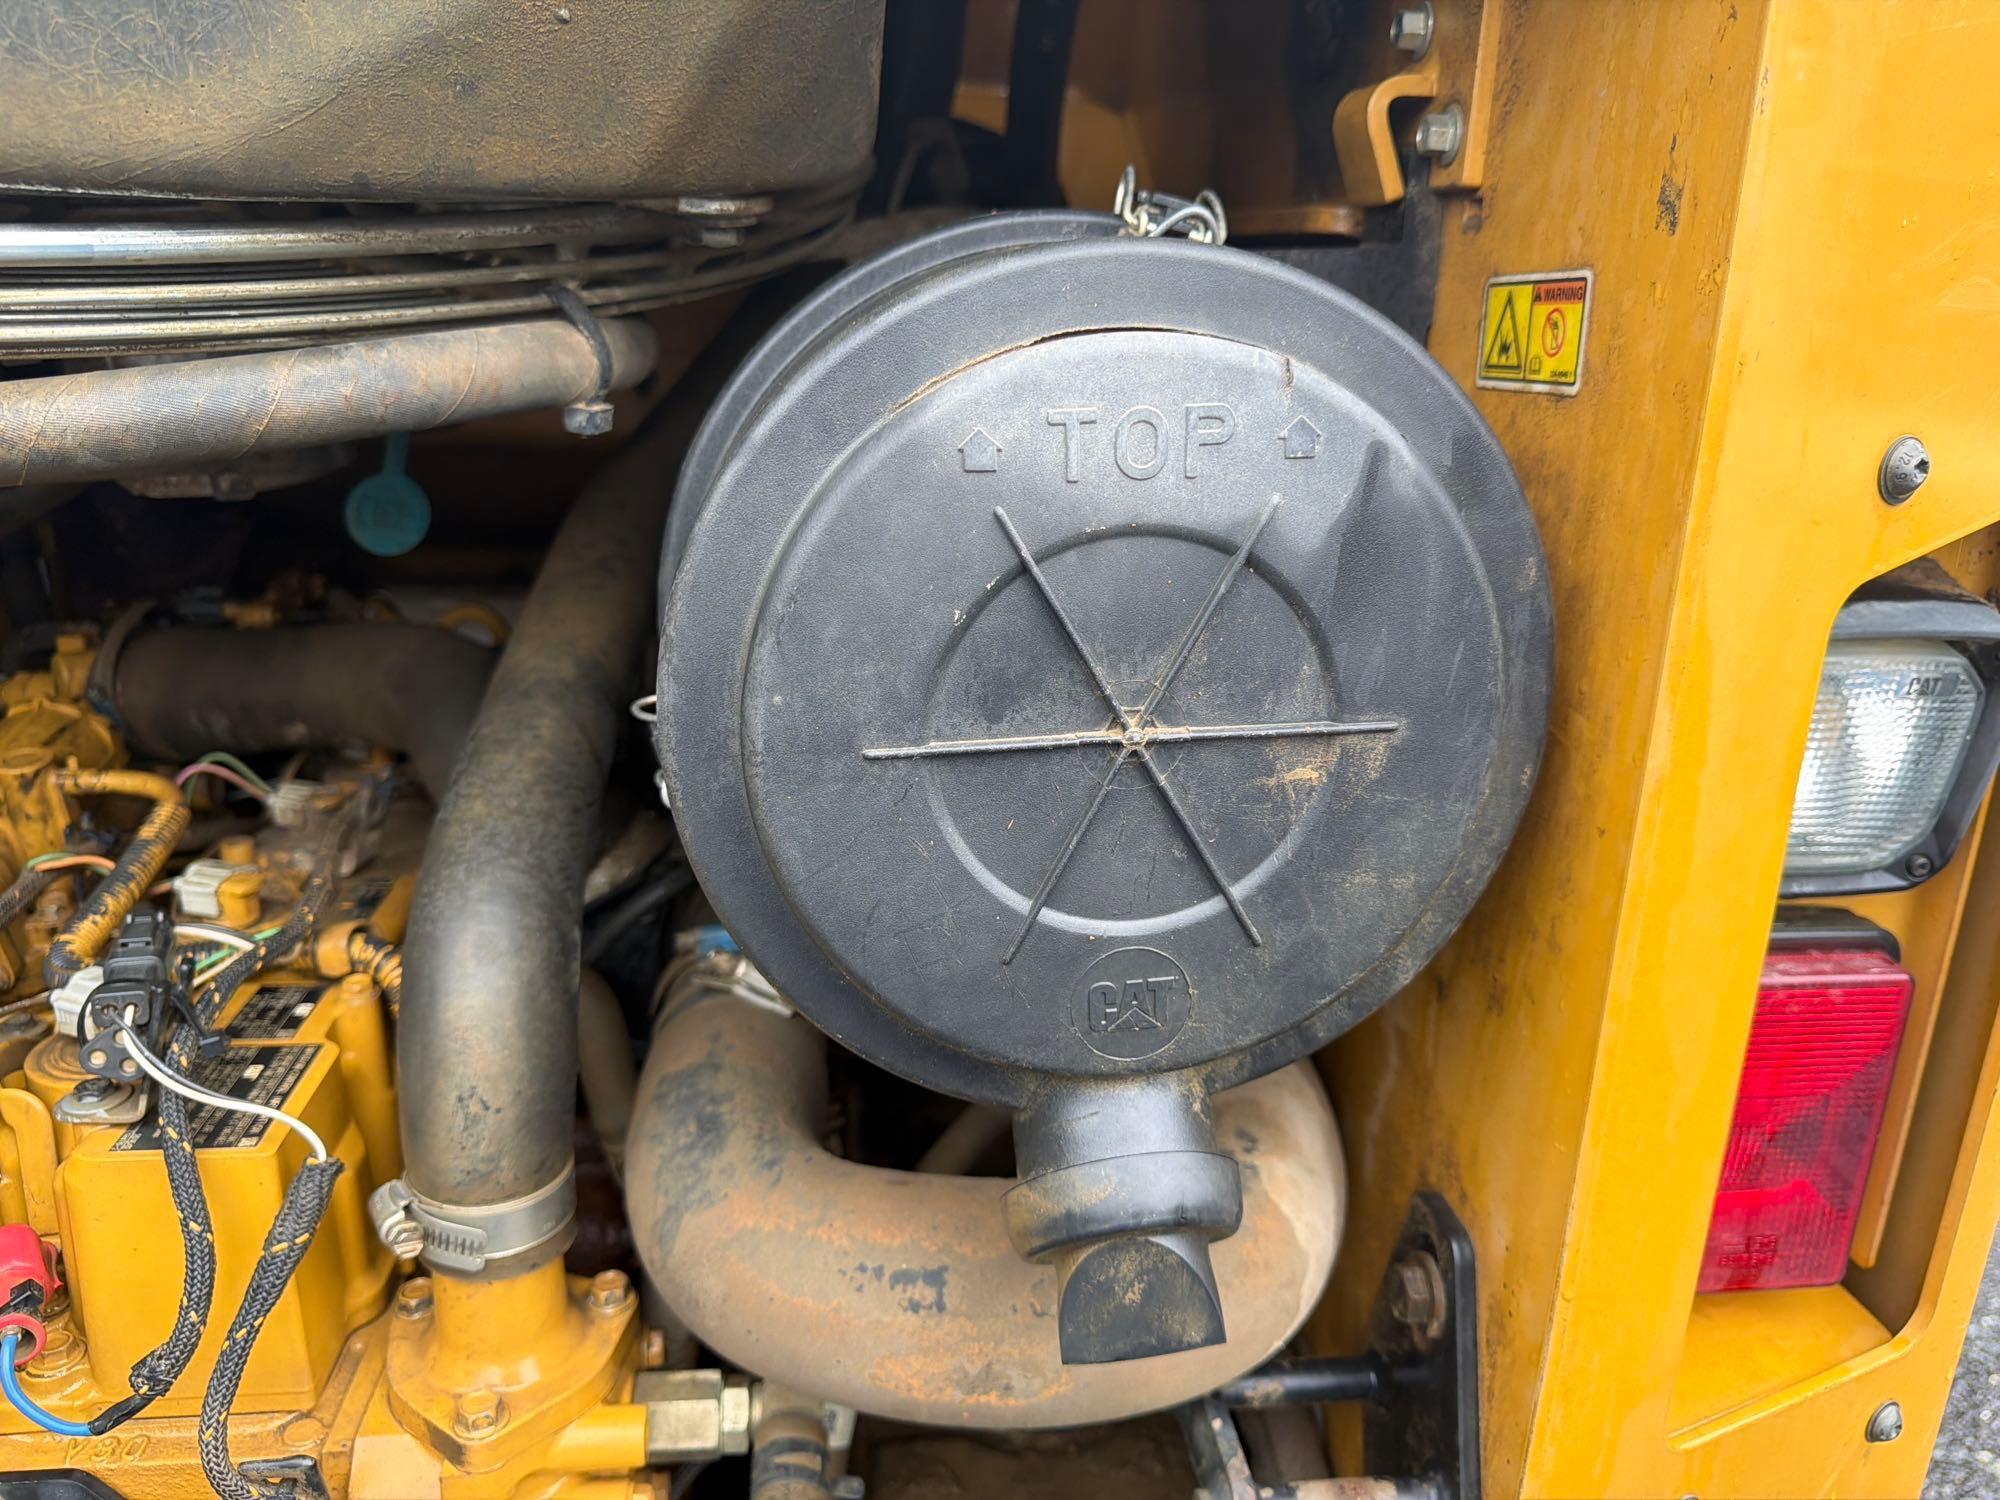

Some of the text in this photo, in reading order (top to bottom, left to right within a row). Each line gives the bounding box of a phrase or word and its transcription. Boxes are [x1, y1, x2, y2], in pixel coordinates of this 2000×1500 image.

[1543, 285, 1584, 302] WARNING
[1046, 402, 1237, 484] TOP
[1905, 676, 1943, 696] CAT
[1087, 975, 1180, 1033] CAT
